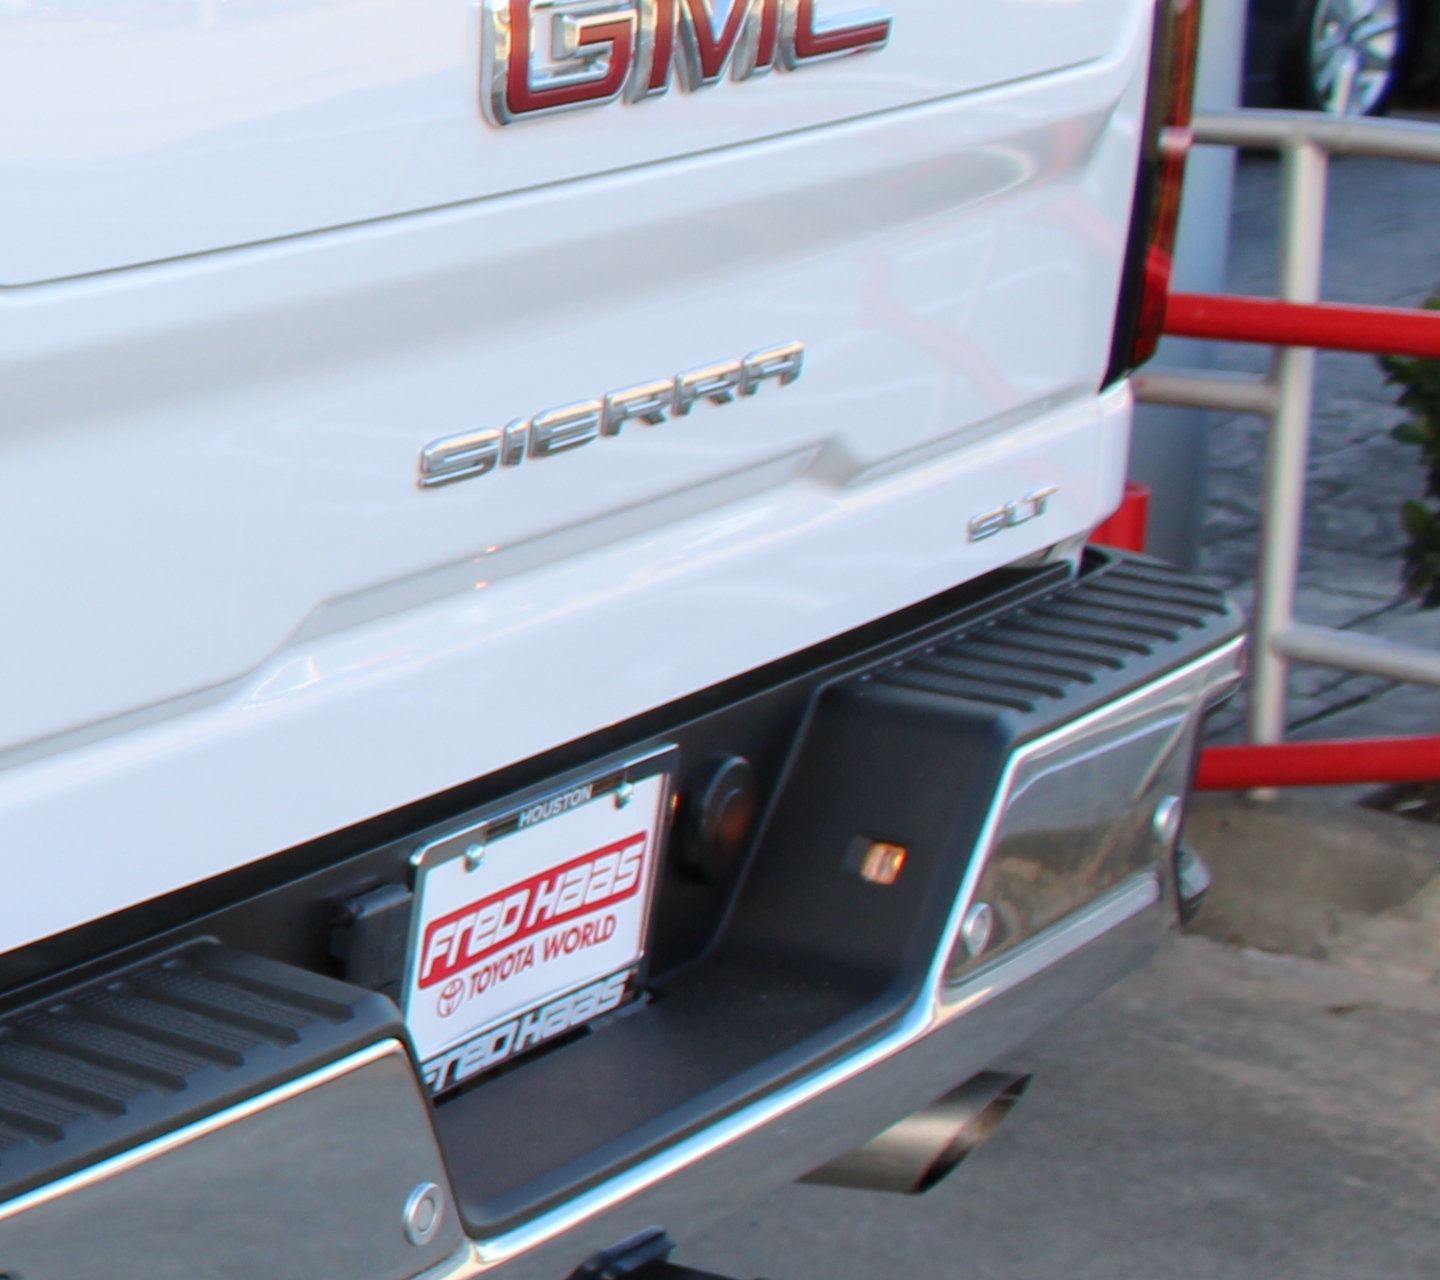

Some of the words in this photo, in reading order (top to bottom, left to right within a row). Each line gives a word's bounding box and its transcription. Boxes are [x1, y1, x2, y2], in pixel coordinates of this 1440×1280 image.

[418, 339, 805, 490] SIERRA
[965, 484, 1060, 544] SLT
[517, 783, 594, 829] HOUSTON
[468, 946, 536, 1000] TOYOTA
[541, 913, 617, 964] WORLD
